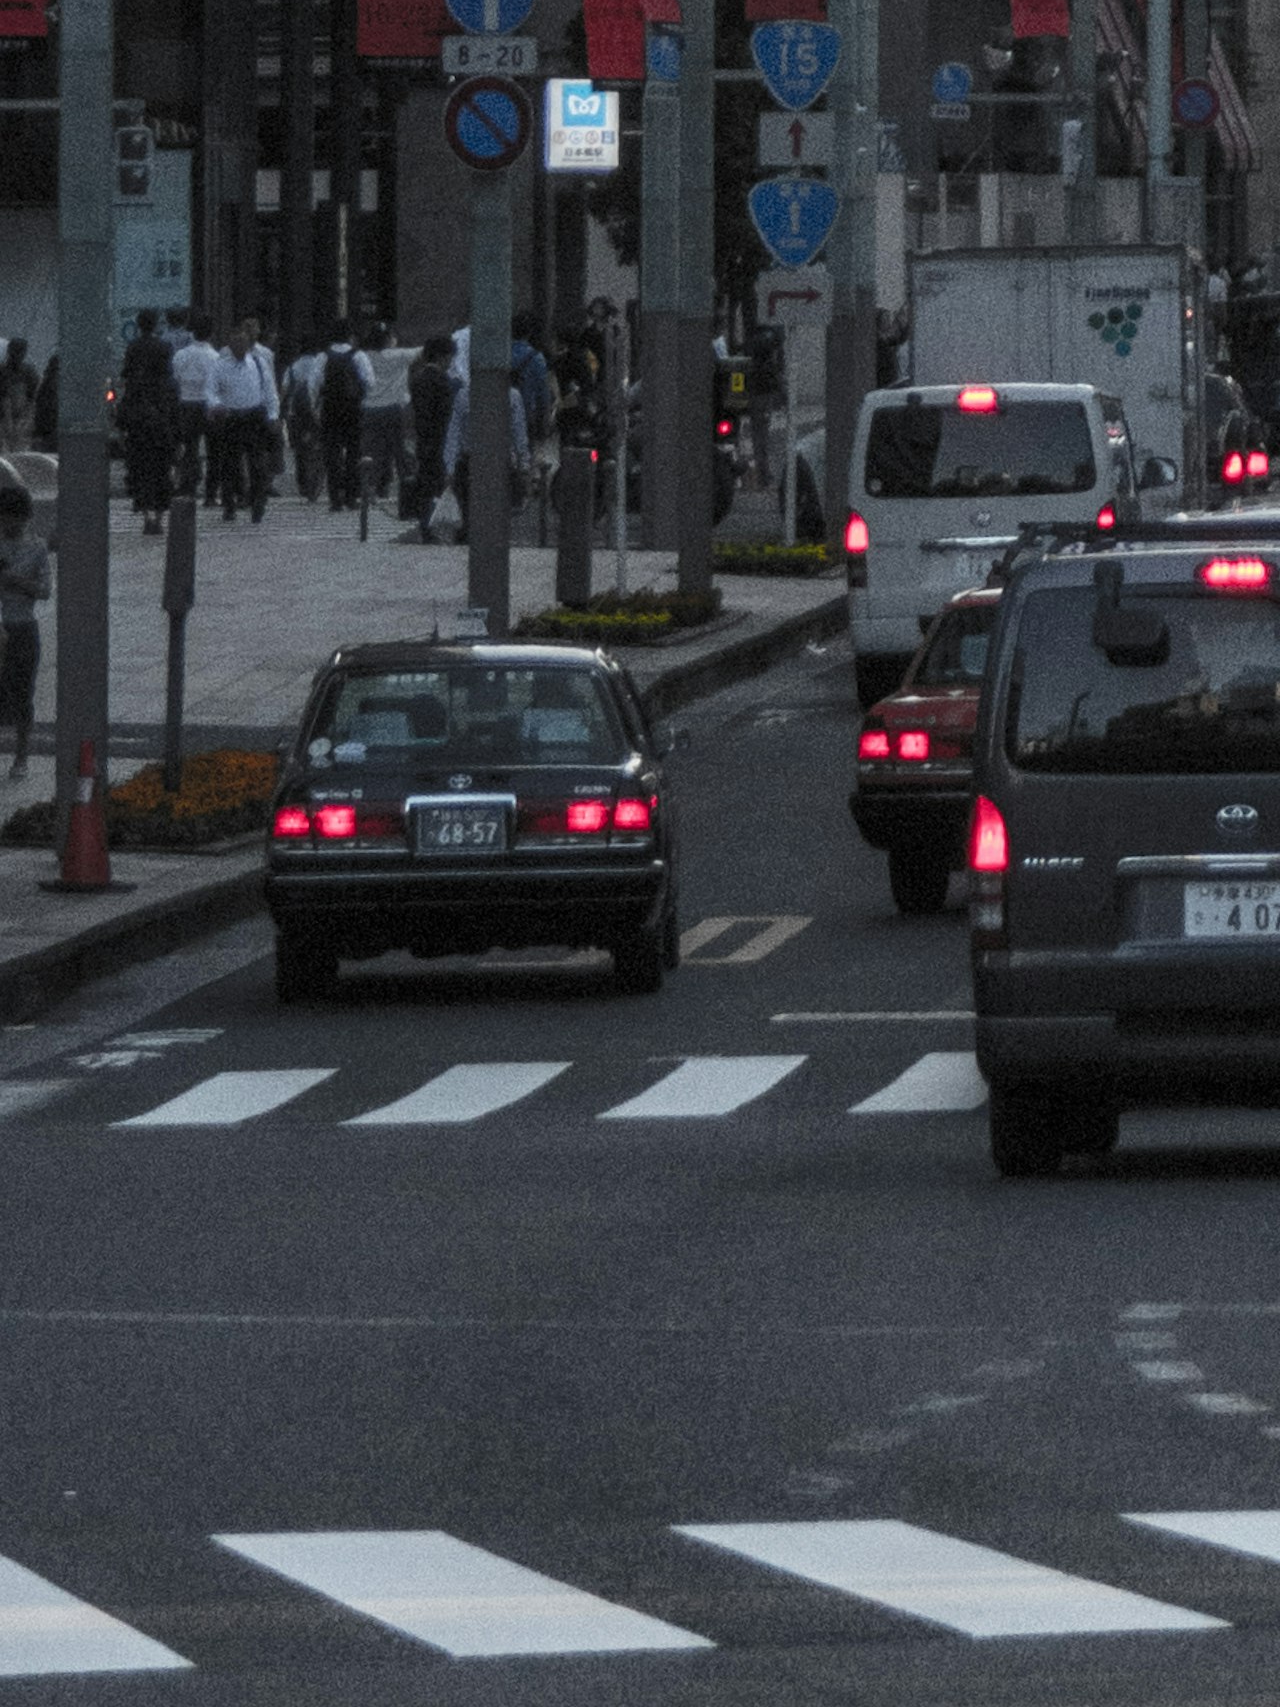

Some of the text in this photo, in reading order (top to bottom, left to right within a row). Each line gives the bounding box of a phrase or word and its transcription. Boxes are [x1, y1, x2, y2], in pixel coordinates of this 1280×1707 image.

[779, 43, 821, 76] 15
[787, 200, 802, 235] 1
[437, 822, 498, 845] 68-57
